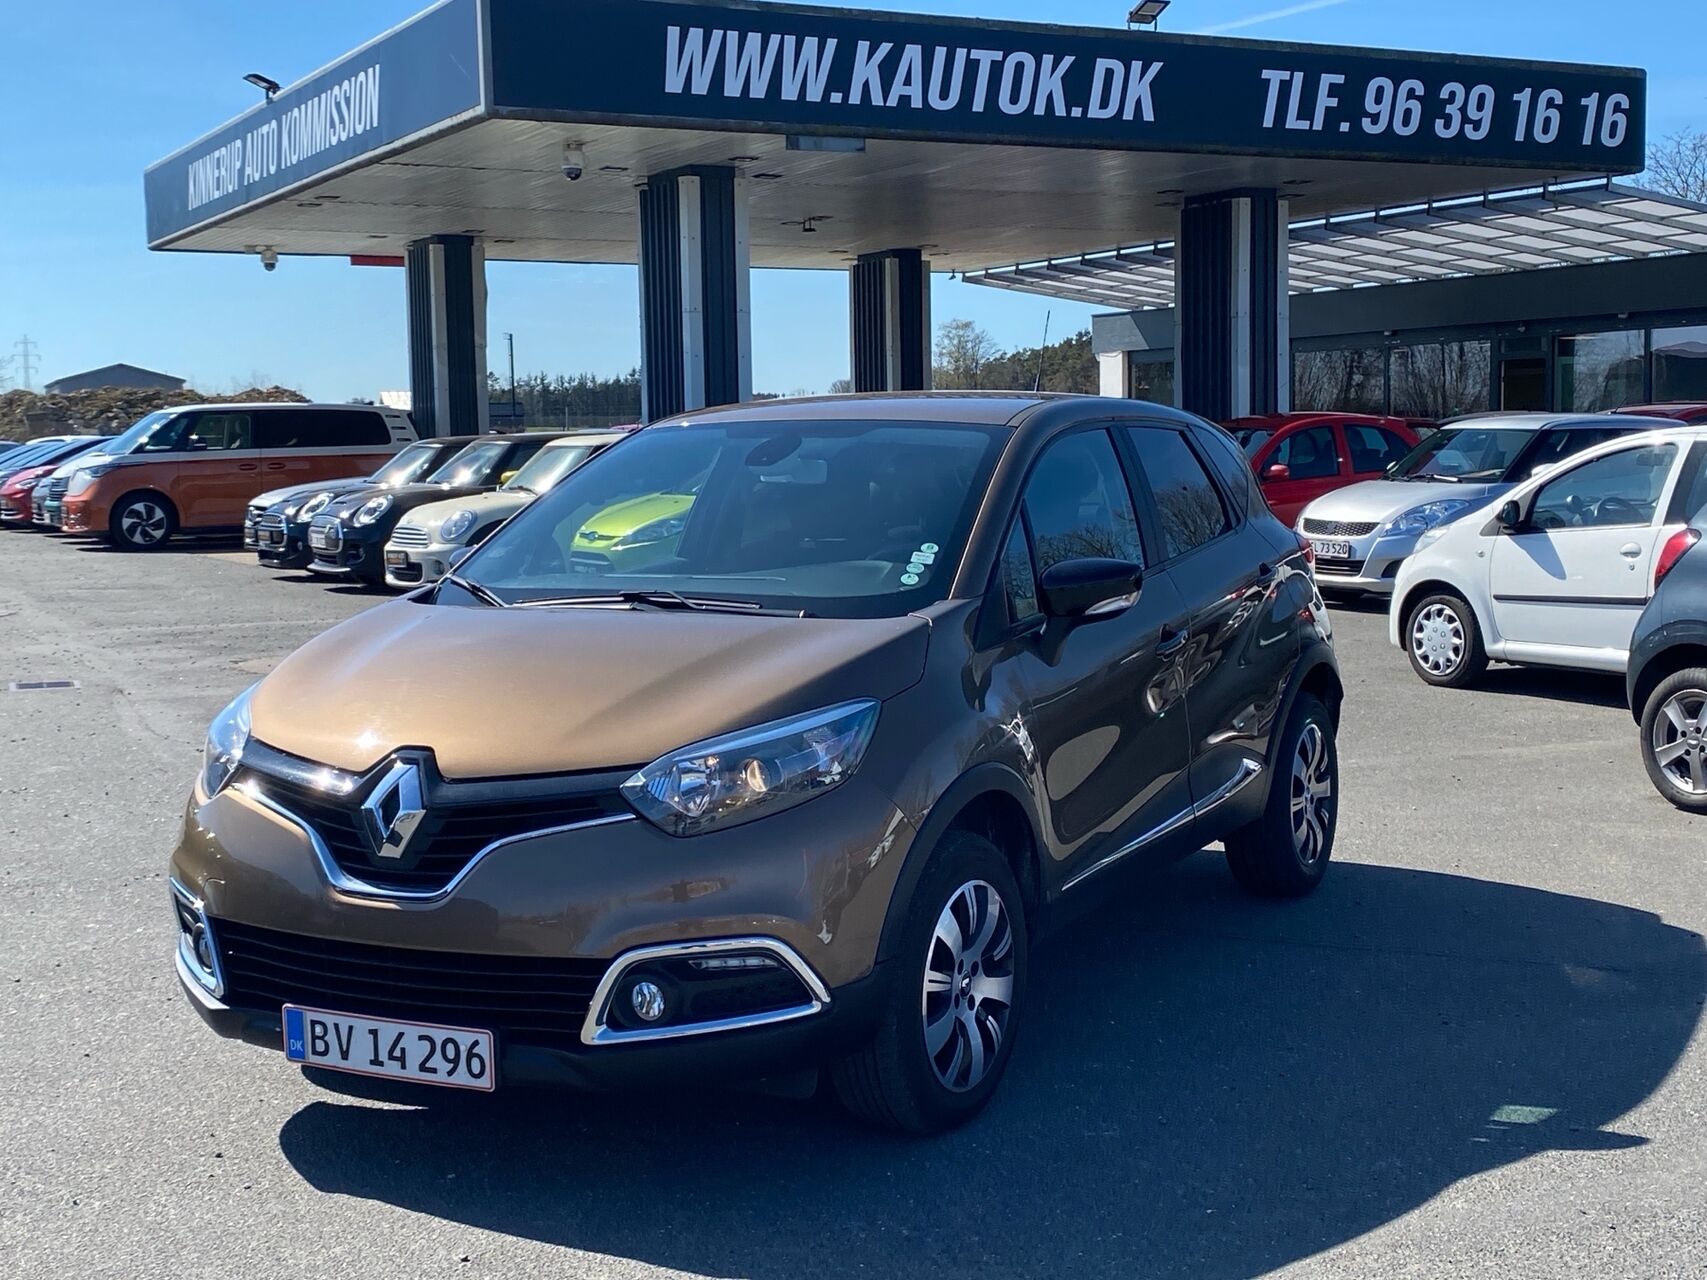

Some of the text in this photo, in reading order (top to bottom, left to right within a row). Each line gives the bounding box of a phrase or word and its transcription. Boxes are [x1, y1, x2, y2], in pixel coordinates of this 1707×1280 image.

[664, 26, 1164, 121] WWW.KAUTOK.DK
[188, 64, 380, 210] KINNERUP AUTO KOMMISSION
[1261, 69, 1630, 148] TLF. 96 39 16 16
[1320, 542, 1330, 554] 73
[1332, 543, 1348, 555] 520
[290, 1039, 304, 1051] DK
[310, 1019, 486, 1079] BV 14 296
